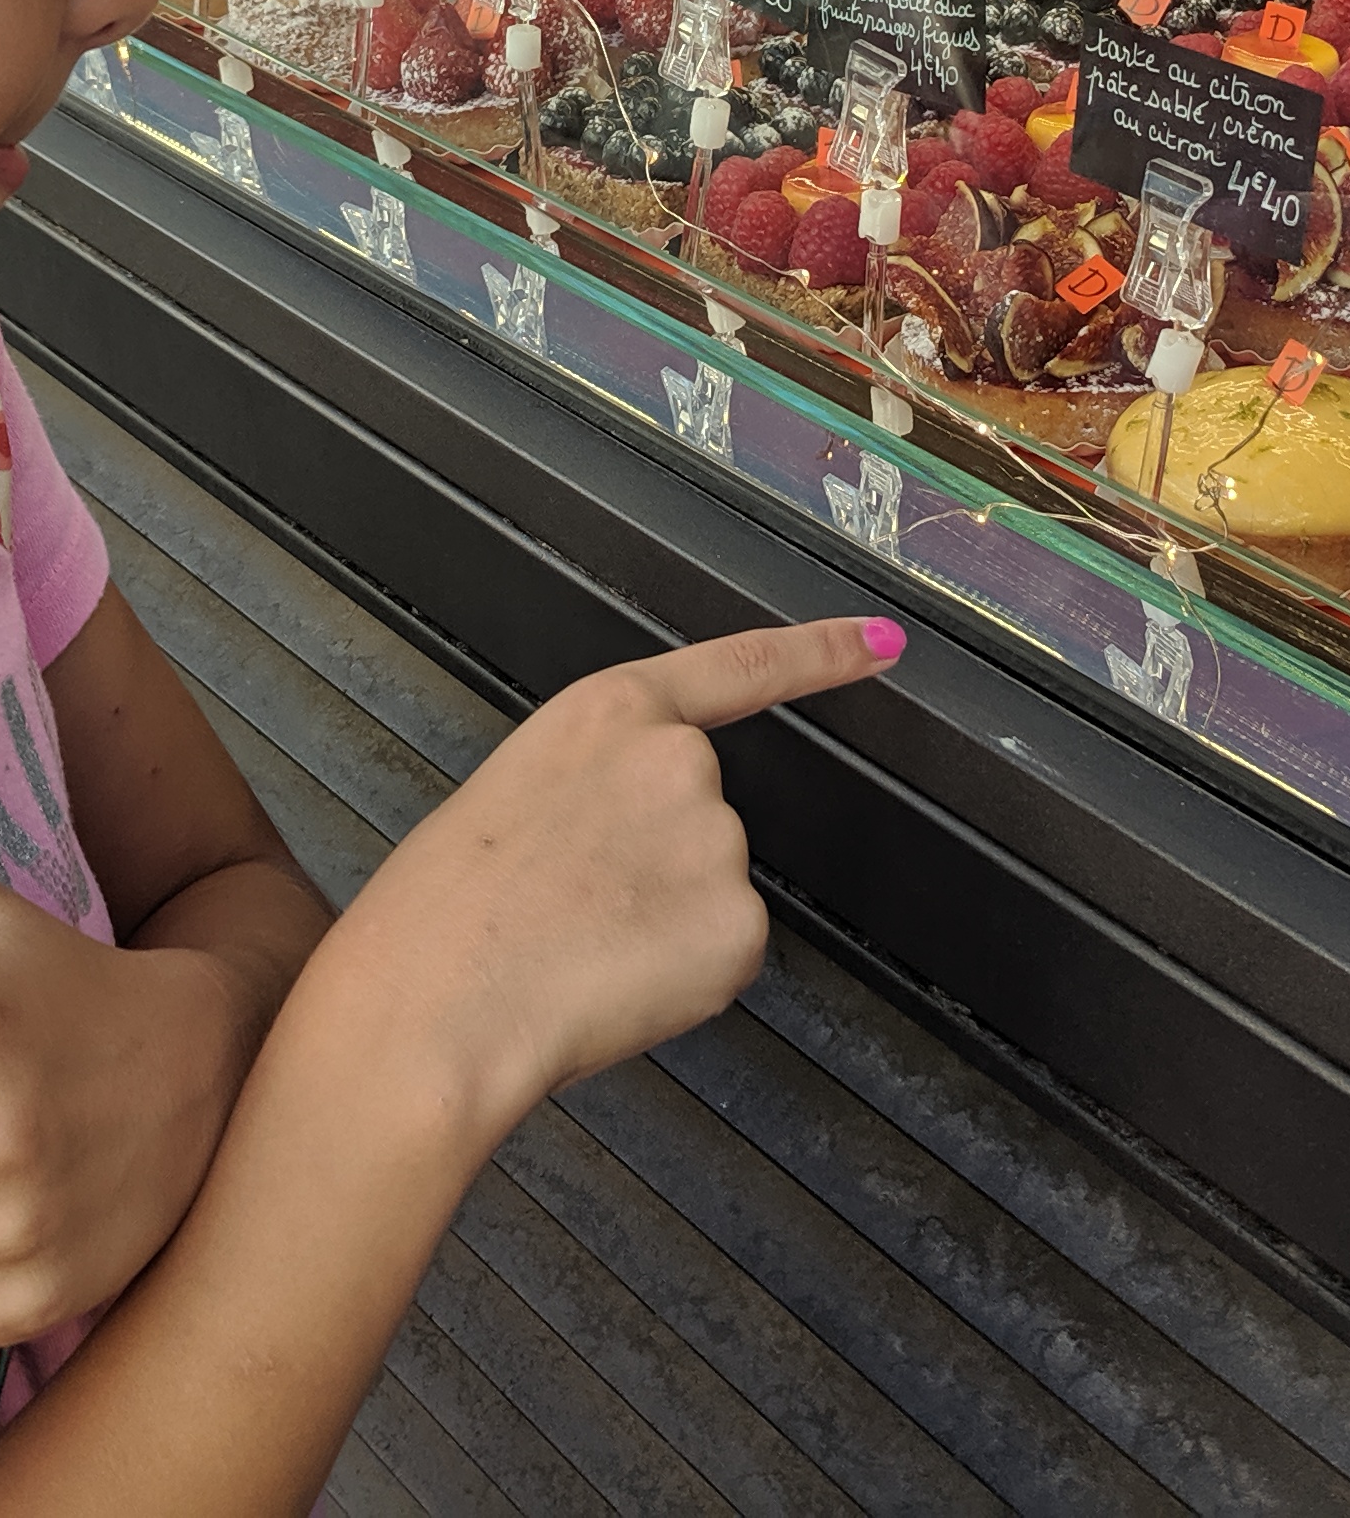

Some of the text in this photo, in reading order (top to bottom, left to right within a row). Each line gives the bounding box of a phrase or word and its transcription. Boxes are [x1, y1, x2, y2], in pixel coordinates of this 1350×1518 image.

[474, 5, 496, 33] D
[922, 15, 981, 60] figues
[1267, 14, 1296, 42] D
[1085, 28, 1296, 121] tarte au citron
[1085, 66, 1141, 106] pâte
[1223, 115, 1305, 161] crème
[1113, 108, 1227, 167] au citron
[1067, 267, 1110, 298] D
